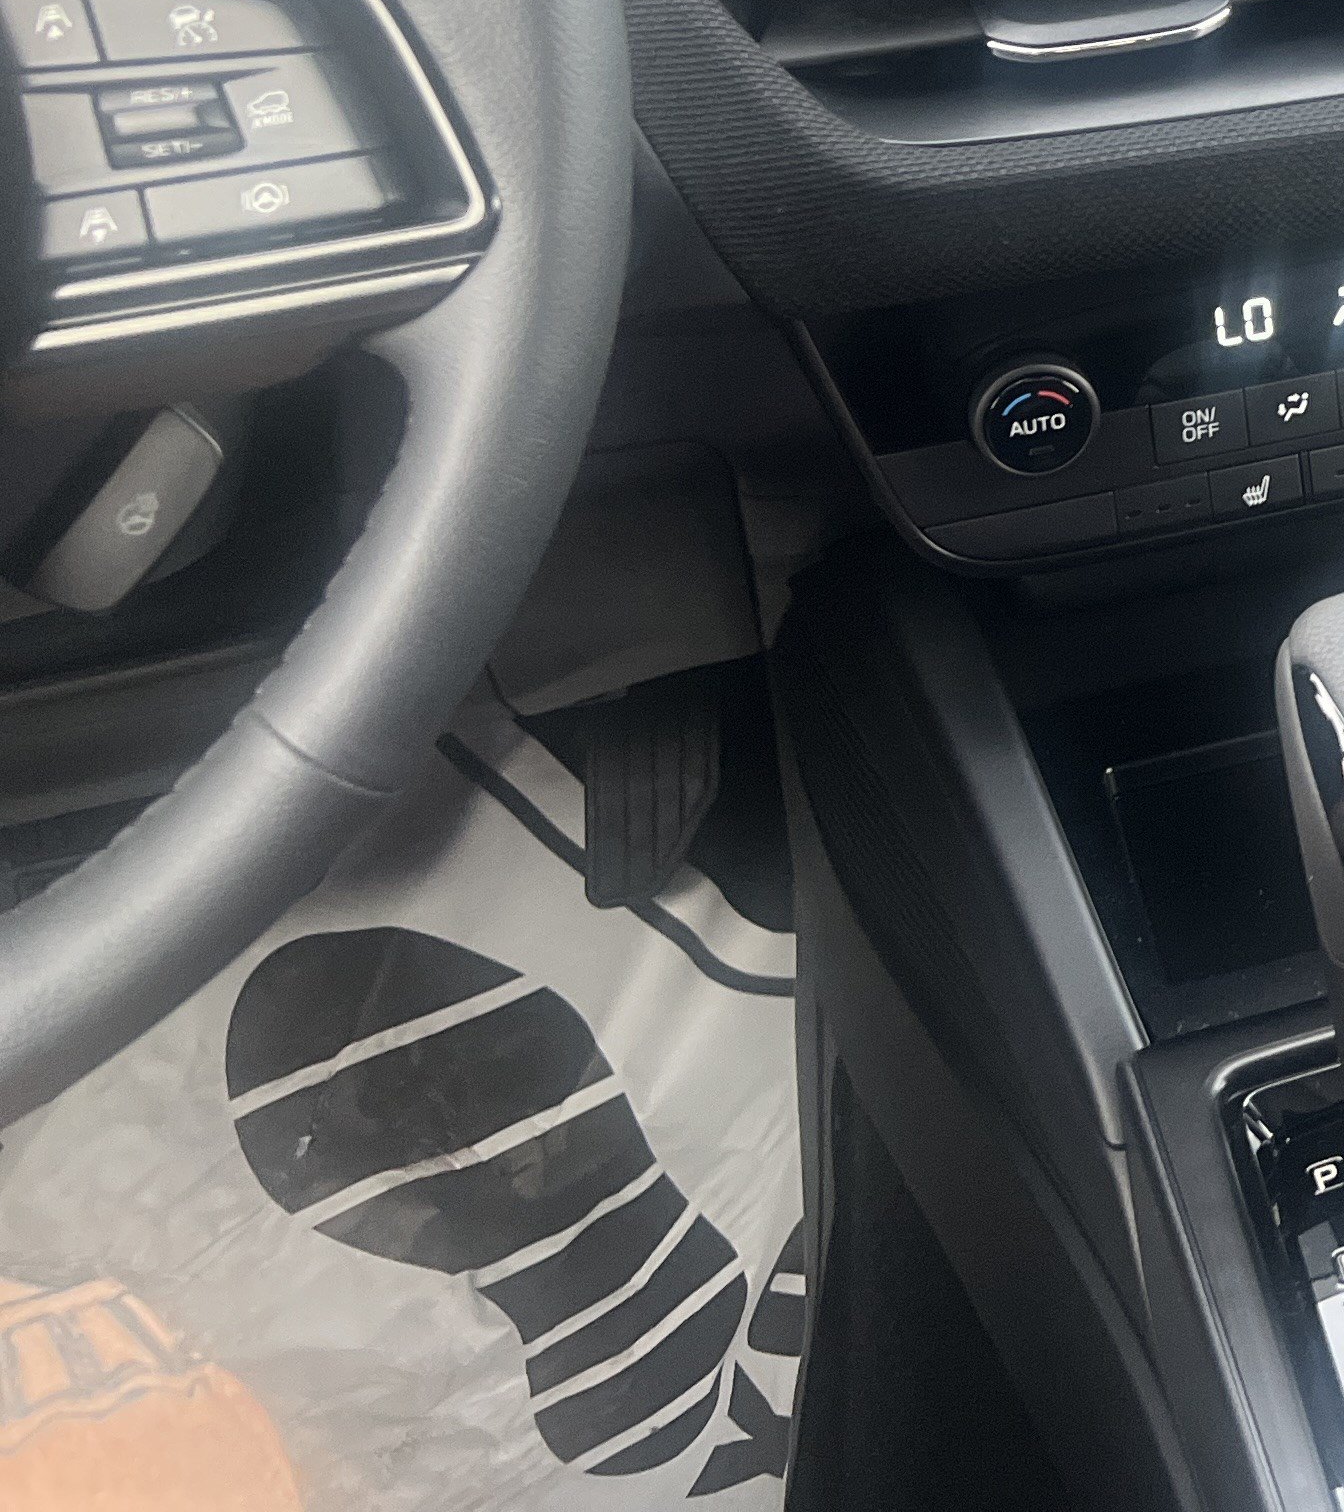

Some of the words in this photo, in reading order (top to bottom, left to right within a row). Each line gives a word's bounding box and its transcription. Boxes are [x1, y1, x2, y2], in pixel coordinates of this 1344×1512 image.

[1214, 296, 1275, 347] LO
[1009, 412, 1067, 438] AUTO
[1182, 406, 1216, 427] ON/
[1182, 421, 1220, 443] OFF
[1312, 1161, 1340, 1192] P
